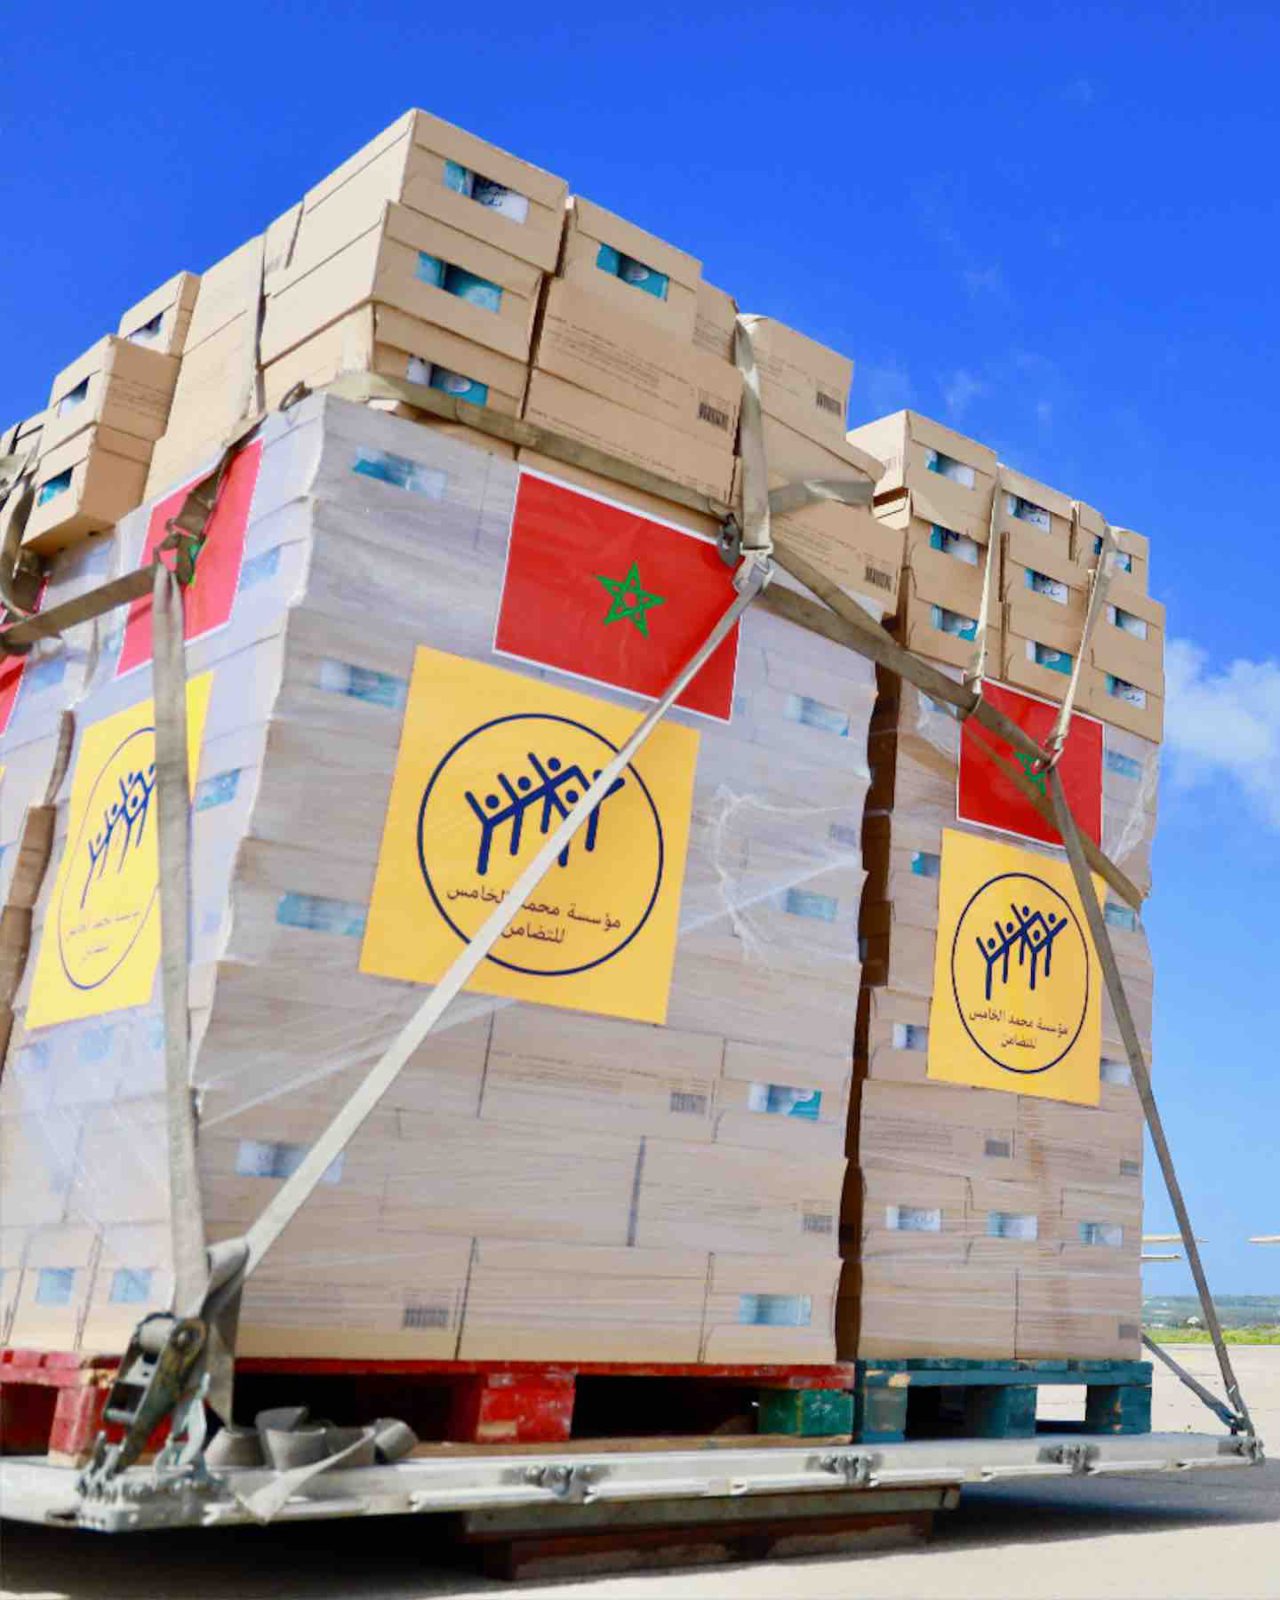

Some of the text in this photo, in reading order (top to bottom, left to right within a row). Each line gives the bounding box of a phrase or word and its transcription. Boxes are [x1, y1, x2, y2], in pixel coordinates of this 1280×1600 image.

[447, 884, 621, 932] مؤسسة محم لخامس
[1008, 1015, 1034, 1028] محمد
[1037, 1017, 1068, 1038] مؤسسة
